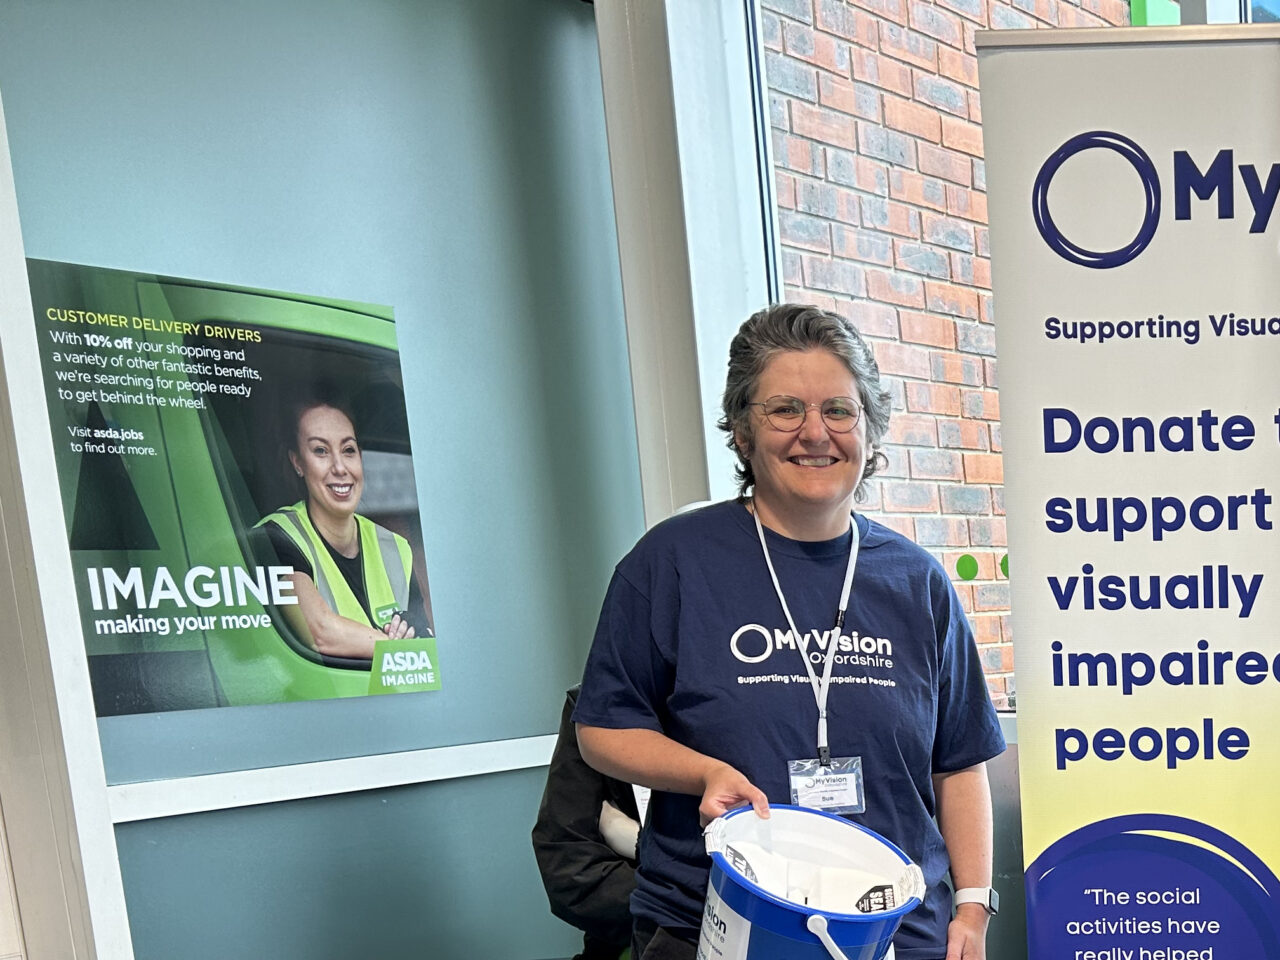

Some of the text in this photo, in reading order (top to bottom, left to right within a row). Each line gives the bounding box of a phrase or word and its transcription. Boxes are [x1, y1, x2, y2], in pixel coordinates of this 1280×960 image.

[46, 307, 262, 342] CUSTOMER DELIVERY DRIVERS
[1044, 315, 1200, 345] Supporting
[49, 330, 245, 361] With 10% off your shopping and
[52, 352, 262, 381] a variety of other fantastic benefits,
[55, 369, 252, 398] we're searching for people ready
[58, 387, 207, 409] to get behind the wheel.
[67, 426, 144, 440] Visit asda.jobs
[1042, 407, 1255, 453] Donate
[70, 441, 157, 456] to find out more.
[1045, 488, 1273, 542] support
[87, 566, 299, 610] IMAGINE
[1047, 563, 1264, 618] visually
[95, 614, 272, 636] making your move
[774, 628, 893, 656] MyVsion
[381, 650, 432, 672] ASDA
[810, 651, 894, 668] Oxordshire
[381, 672, 435, 687] IMAGINE
[737, 674, 789, 684] Supporting
[829, 675, 867, 684] mpaired
[868, 677, 896, 687] People
[1055, 718, 1250, 770] people
[1136, 887, 1200, 906] social
[1066, 916, 1220, 936] activities have
